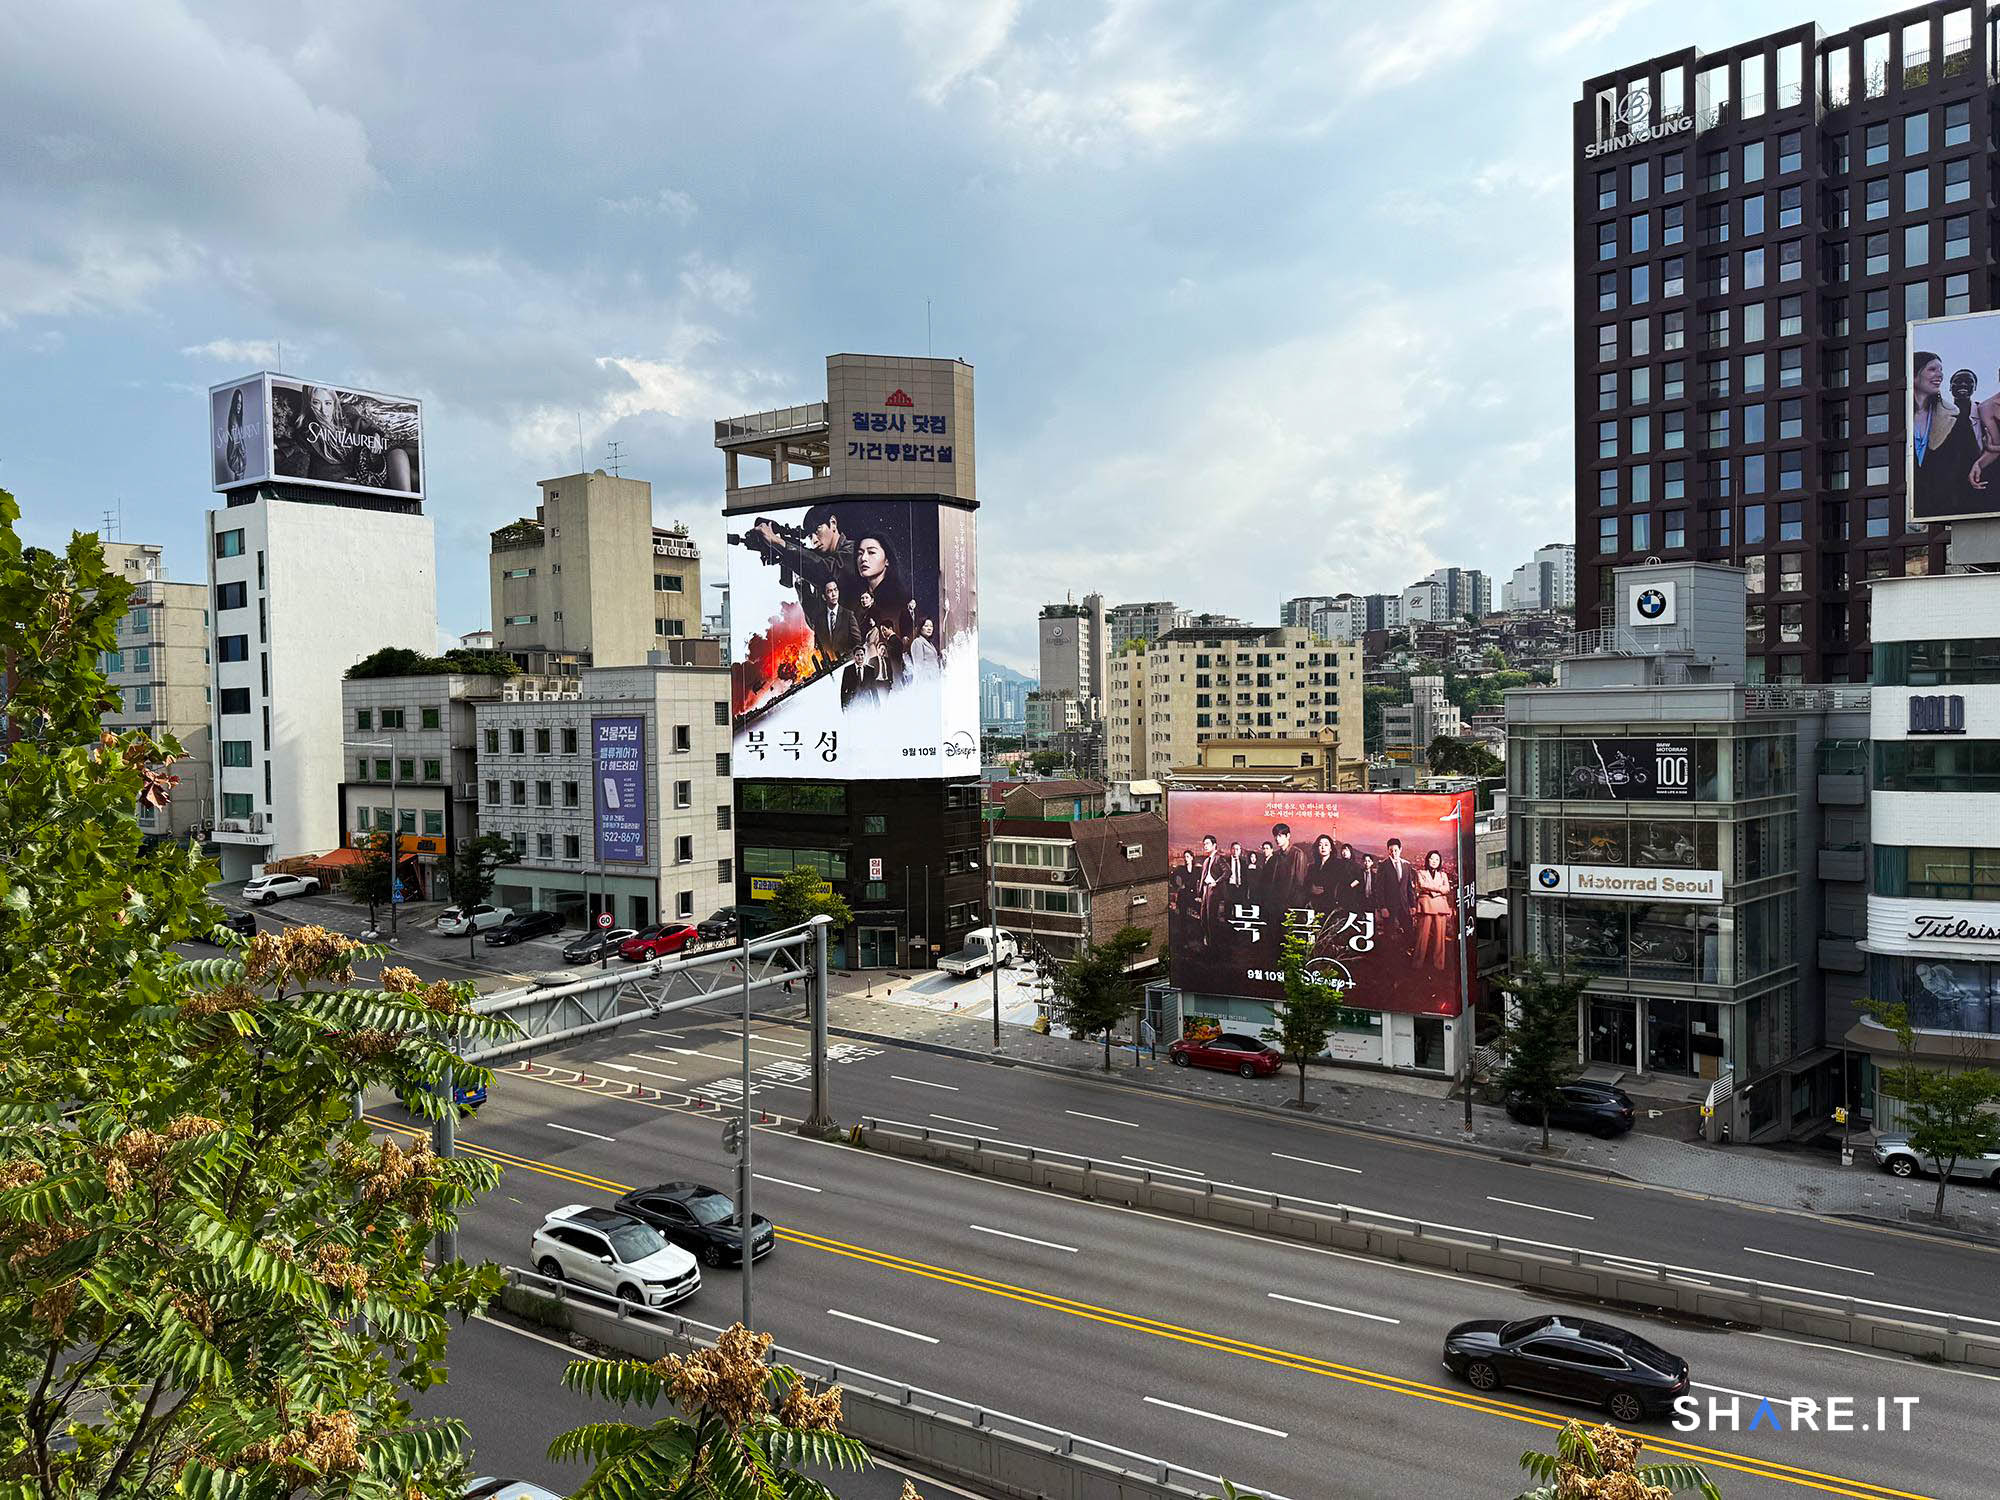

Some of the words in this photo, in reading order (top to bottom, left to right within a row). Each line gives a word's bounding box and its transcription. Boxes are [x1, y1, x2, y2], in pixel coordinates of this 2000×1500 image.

[1584, 116, 1693, 159] SHINYOUNG
[852, 412, 906, 432] 칠공사
[912, 414, 946, 434] 닷컴
[1909, 695, 1965, 731] BOLD
[600, 726, 638, 741] 건물주님
[902, 748, 916, 757] 9월
[918, 747, 937, 756] 10일
[600, 760, 608, 771] 다
[1655, 757, 1689, 786] 100
[1578, 874, 1658, 891] Motorrad
[1661, 877, 1713, 894] Seoul
[600, 916, 611, 925] 60
[1247, 969, 1263, 980] 9월
[1264, 971, 1285, 982] 10일
